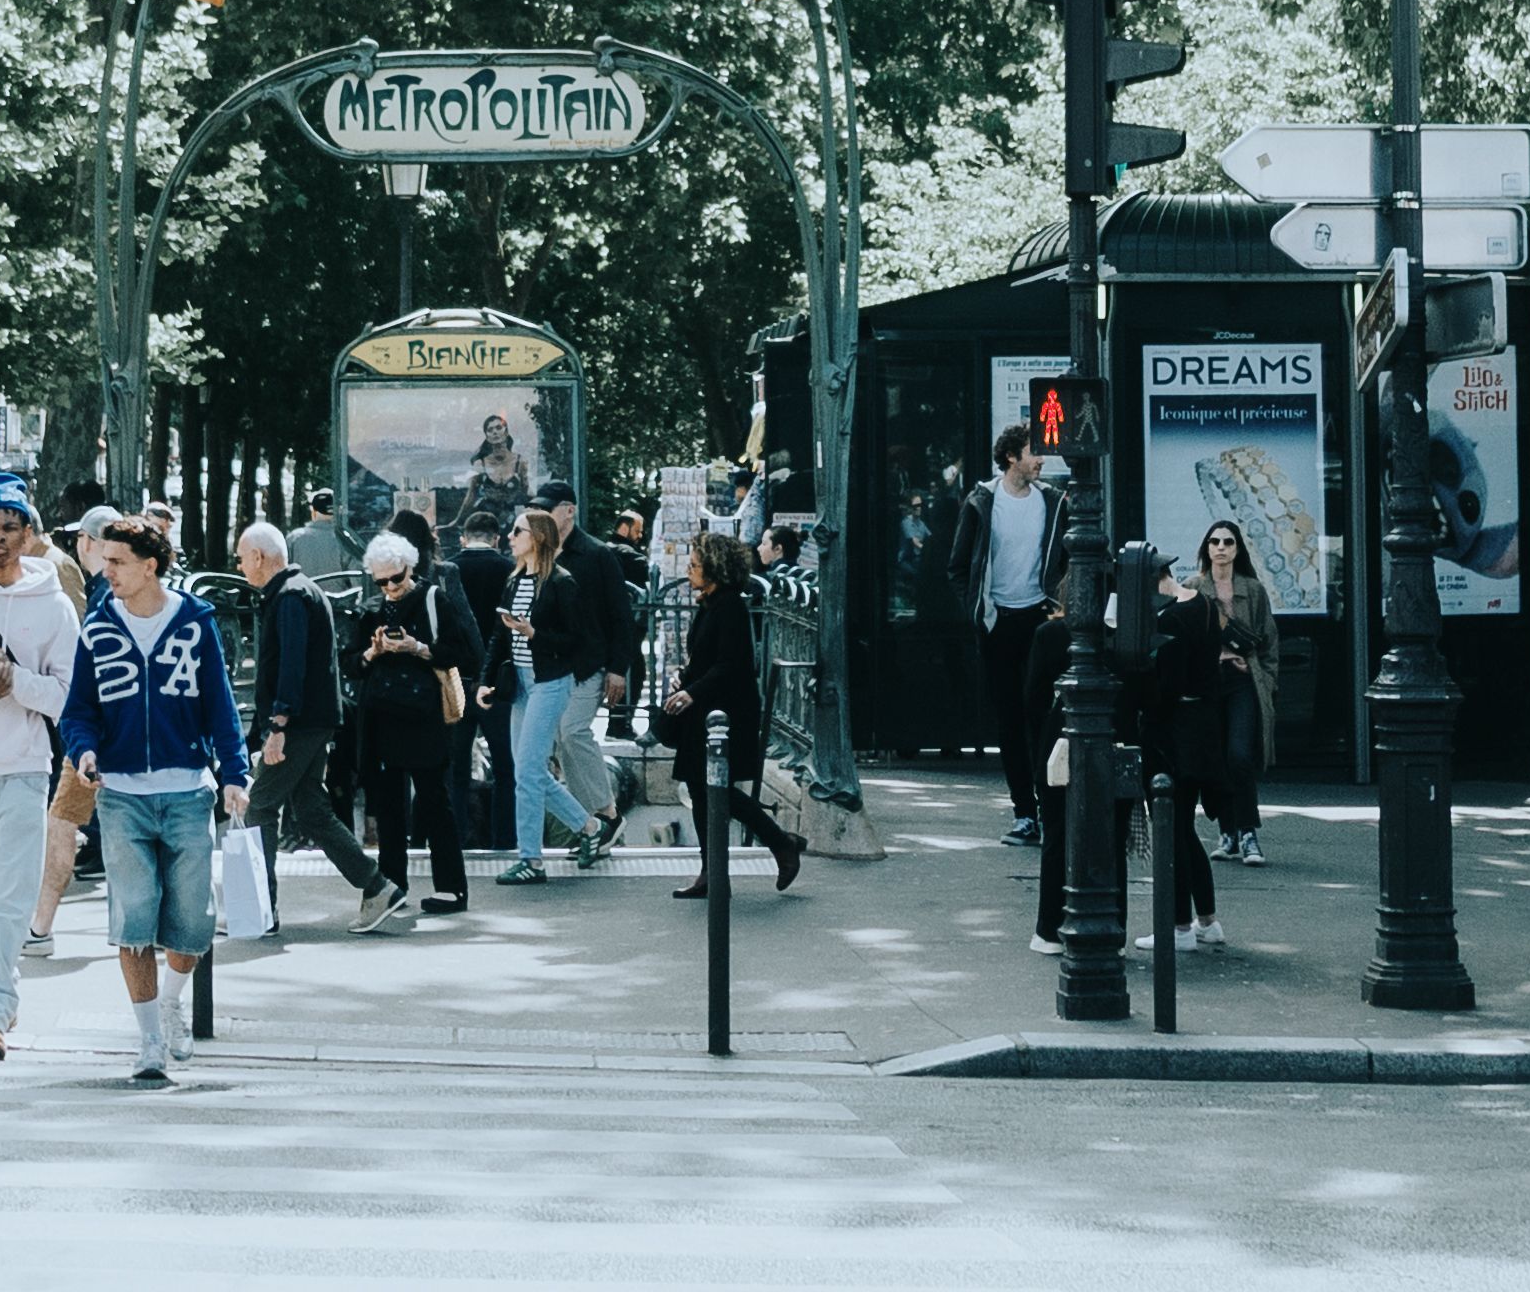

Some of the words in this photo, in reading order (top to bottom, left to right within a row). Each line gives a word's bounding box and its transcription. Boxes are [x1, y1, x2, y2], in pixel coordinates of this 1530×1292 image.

[339, 68, 632, 144] METROPOLITAIN
[1213, 332, 1255, 340] JCDecaux
[407, 339, 511, 370] BLANCHE
[1152, 355, 1313, 385] DREAMS
[1494, 373, 1503, 386] &
[1160, 404, 1222, 426] Iconique
[1224, 405, 1238, 420] et
[1241, 404, 1308, 426] précieuse
